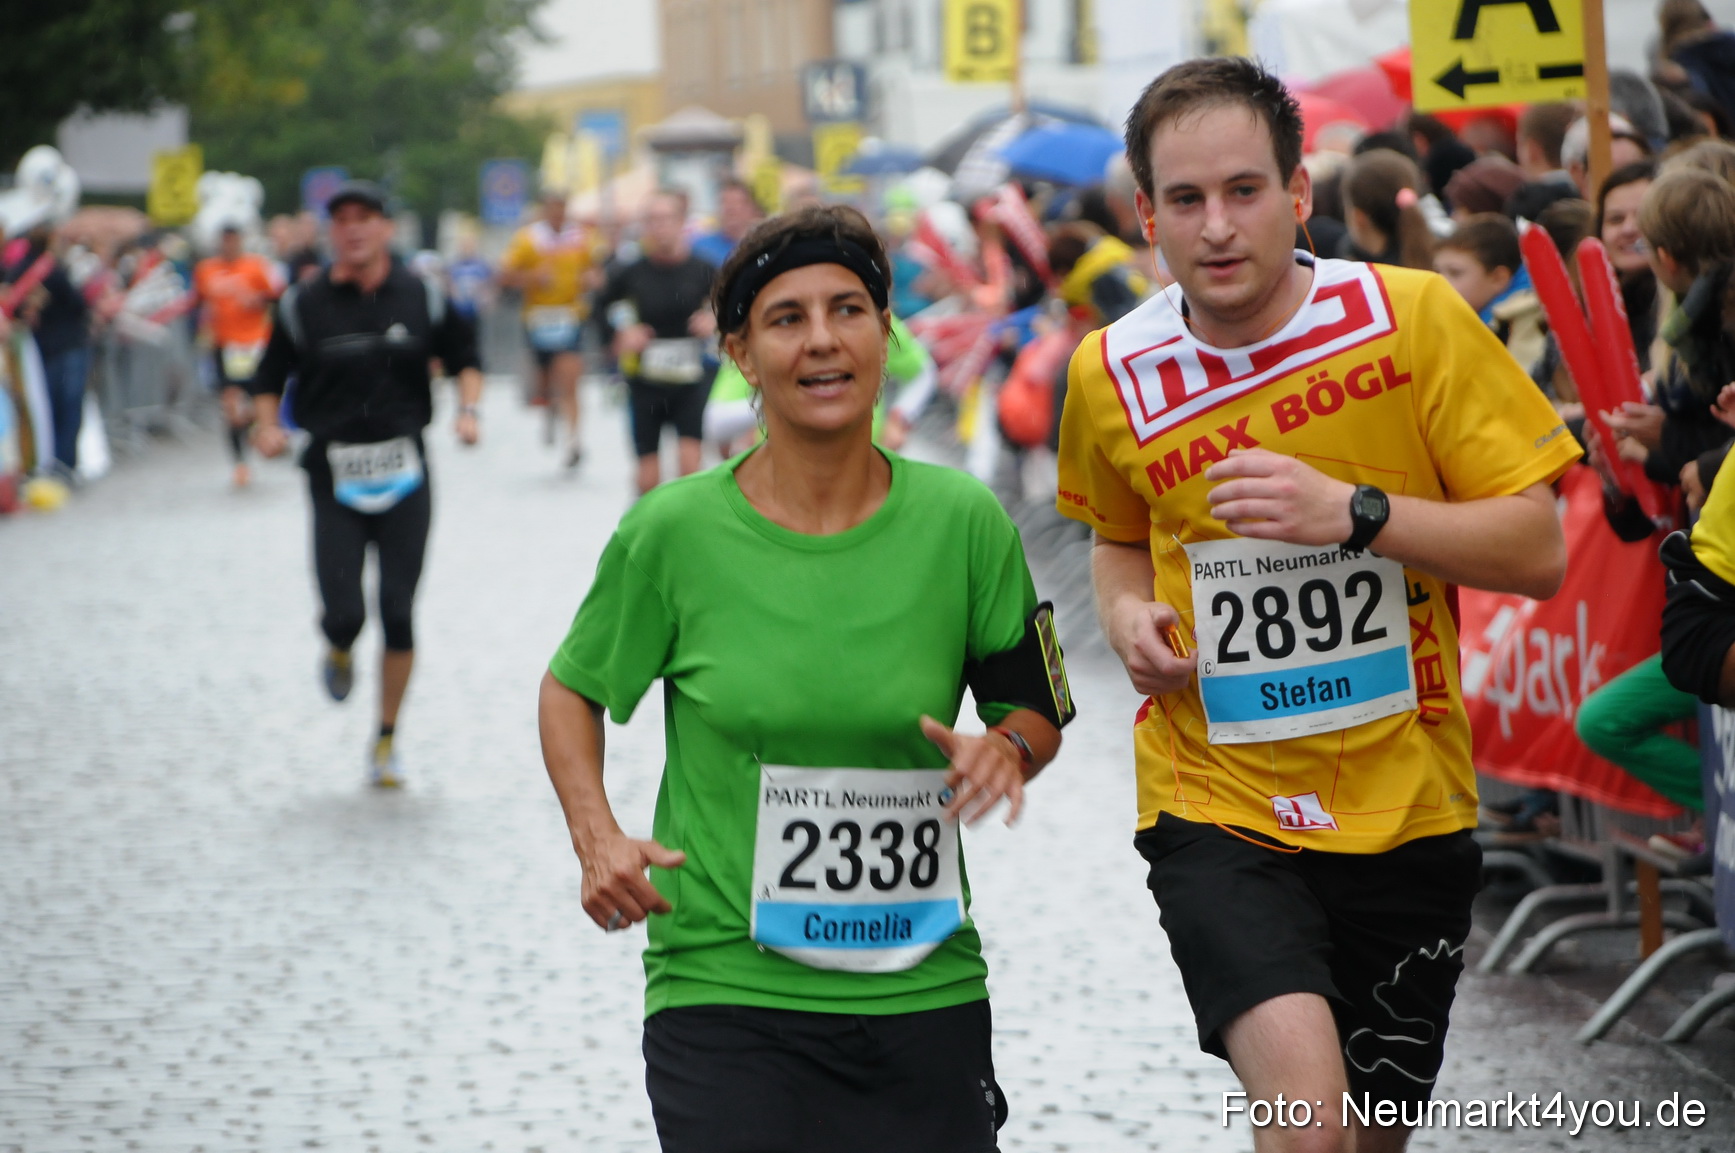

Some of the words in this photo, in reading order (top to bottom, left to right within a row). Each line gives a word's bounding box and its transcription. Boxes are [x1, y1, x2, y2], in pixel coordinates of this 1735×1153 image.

[964, 3, 1003, 59] B
[1145, 415, 1261, 498] MAX
[1270, 355, 1412, 435] BÖGL
[1194, 560, 1252, 581] PARTL
[1211, 570, 1388, 664] 2892
[1260, 676, 1352, 711] Stefan
[765, 787, 837, 809] PARTL
[841, 788, 933, 809] Neumarkt
[779, 818, 941, 891] 2338
[803, 912, 913, 942] Cornelia
